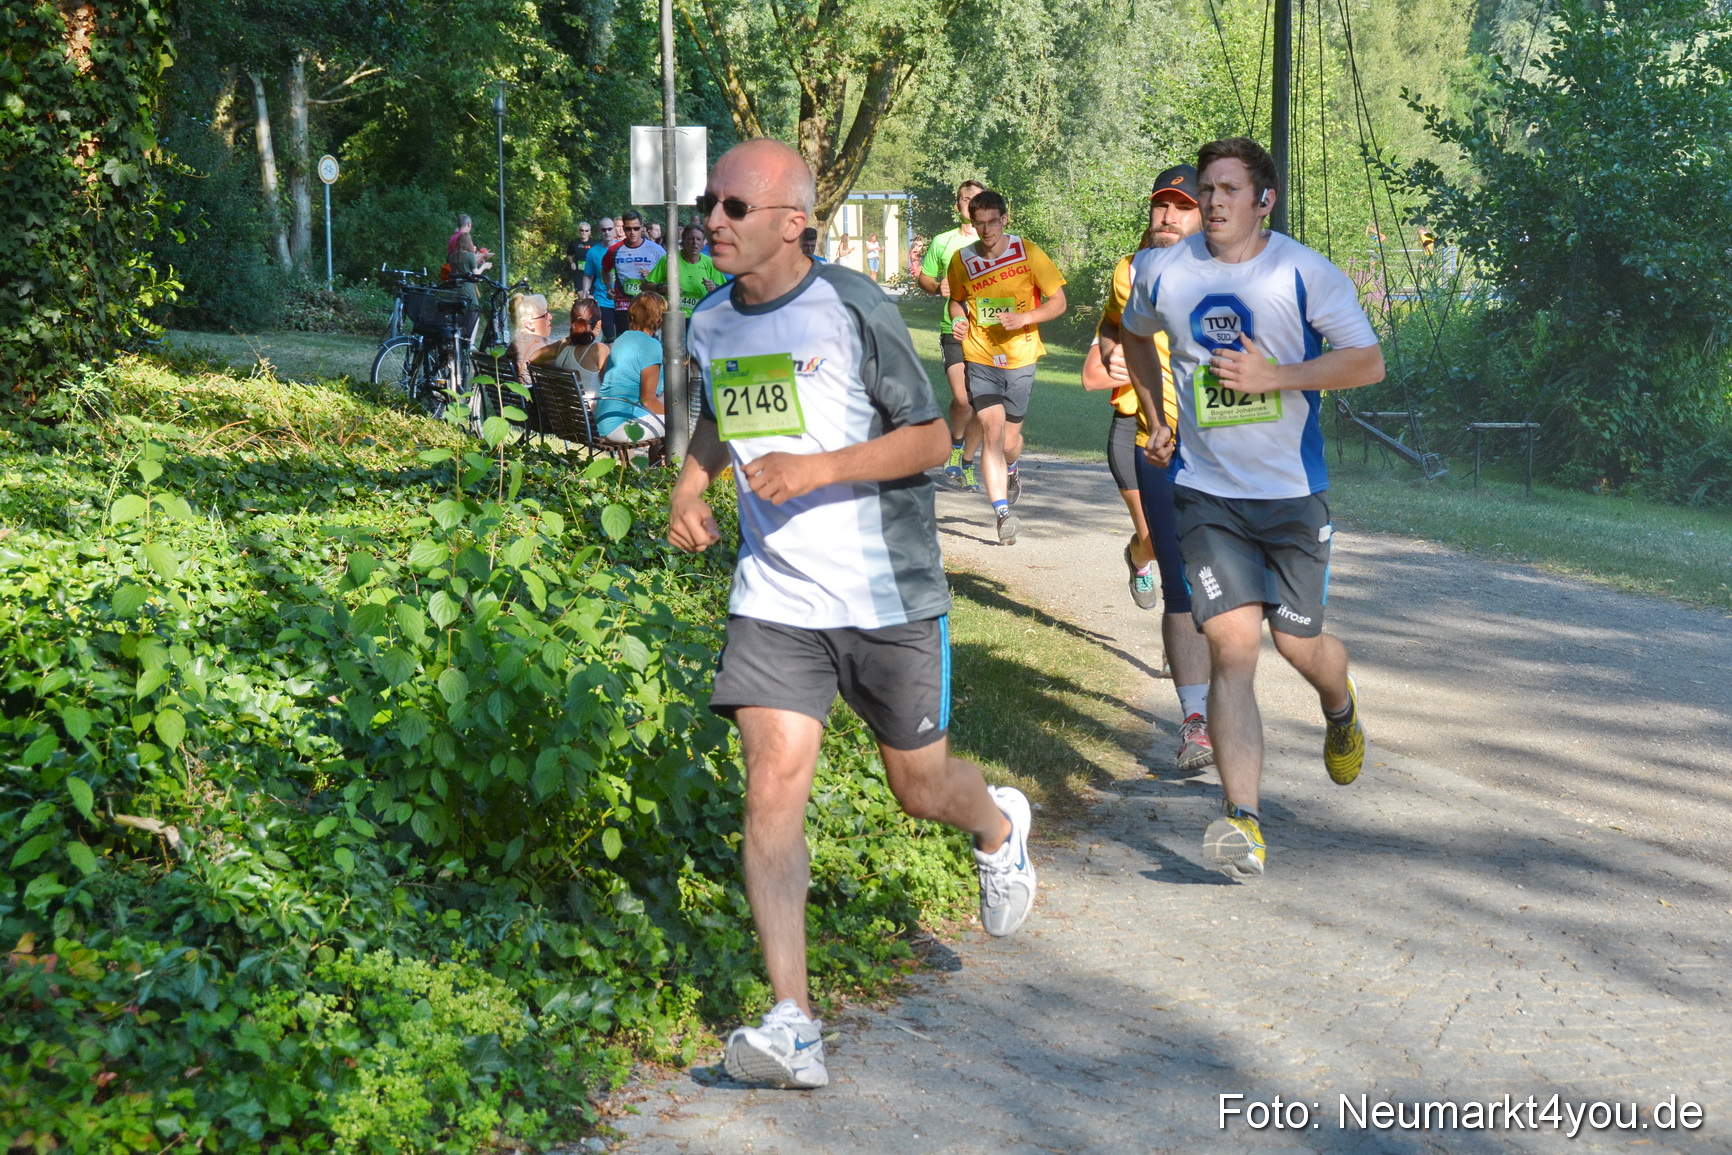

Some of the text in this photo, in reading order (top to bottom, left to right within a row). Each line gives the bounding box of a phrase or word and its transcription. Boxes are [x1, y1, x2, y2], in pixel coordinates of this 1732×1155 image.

[971, 265, 1031, 292] MAX BÖGL
[681, 297, 697, 306] 440
[1204, 316, 1238, 330] TÜV
[1216, 332, 1231, 341] SÜD
[723, 384, 788, 417] 2148
[1210, 405, 1267, 417] Bogner Johannes
[1276, 604, 1312, 626] itrose
